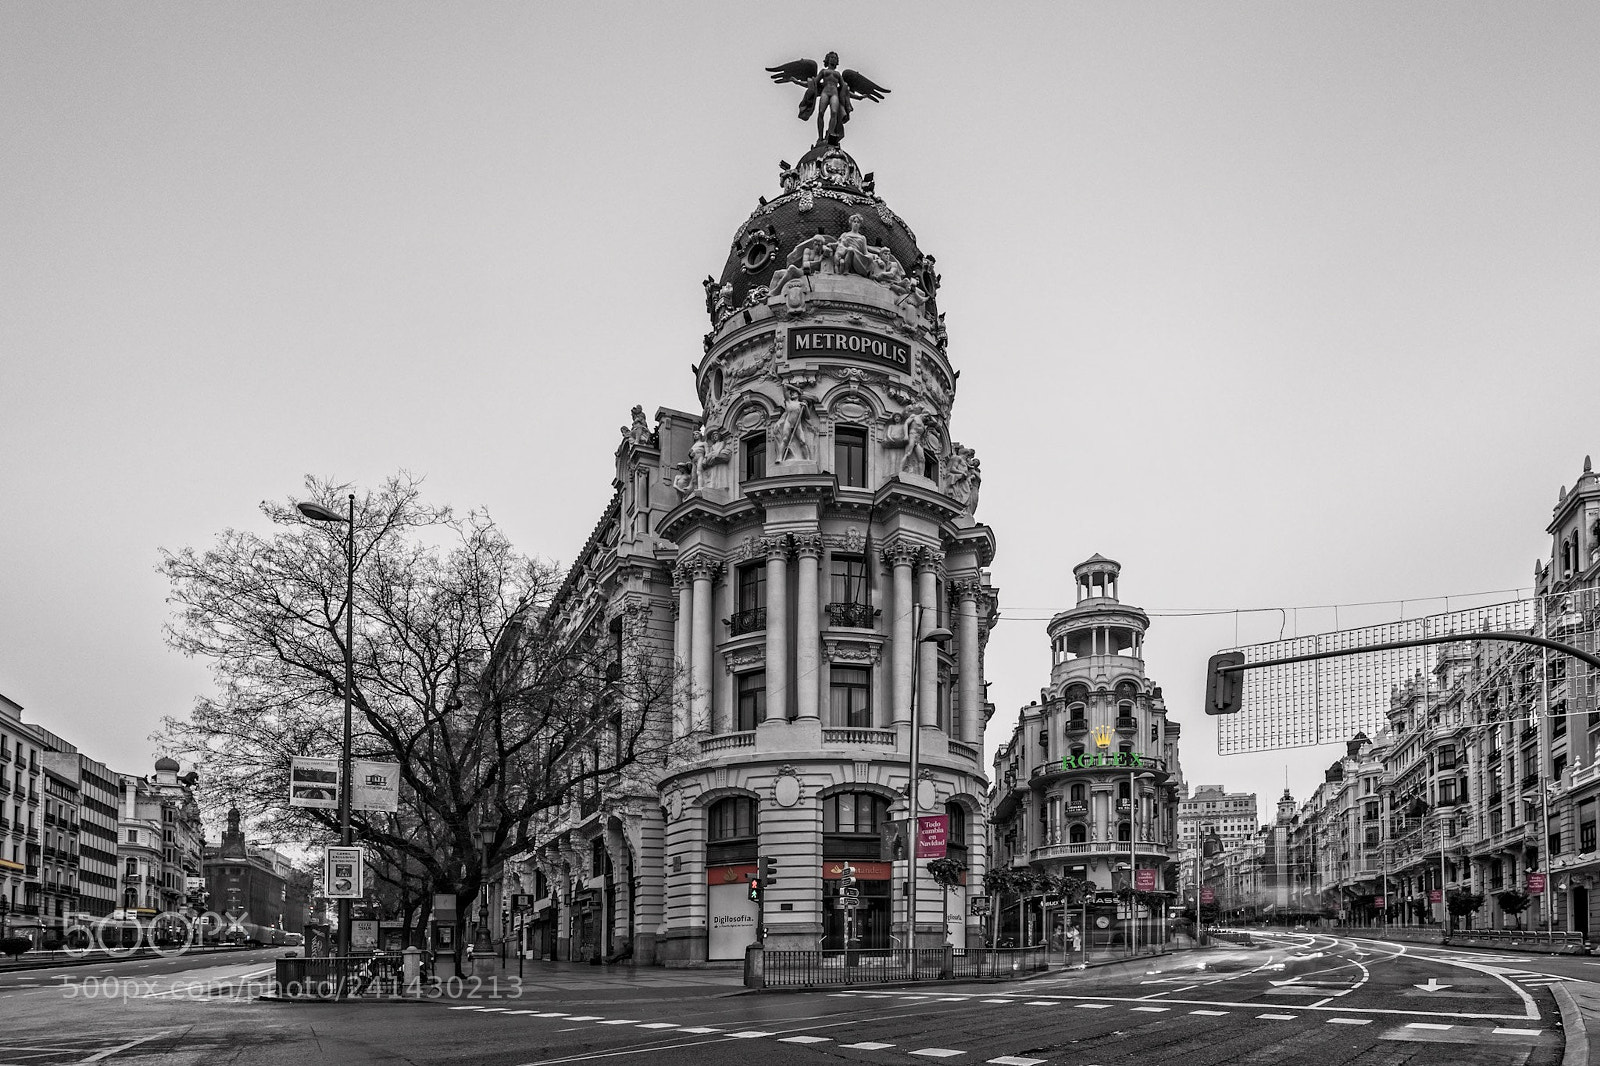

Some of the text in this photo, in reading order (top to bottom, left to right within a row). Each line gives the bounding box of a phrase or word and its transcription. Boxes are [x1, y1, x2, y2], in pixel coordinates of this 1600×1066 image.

[795, 333, 907, 364] METROPOLIS
[1061, 752, 1143, 771] ROLEX
[921, 827, 944, 835] cambia
[919, 839, 945, 847] Navidad
